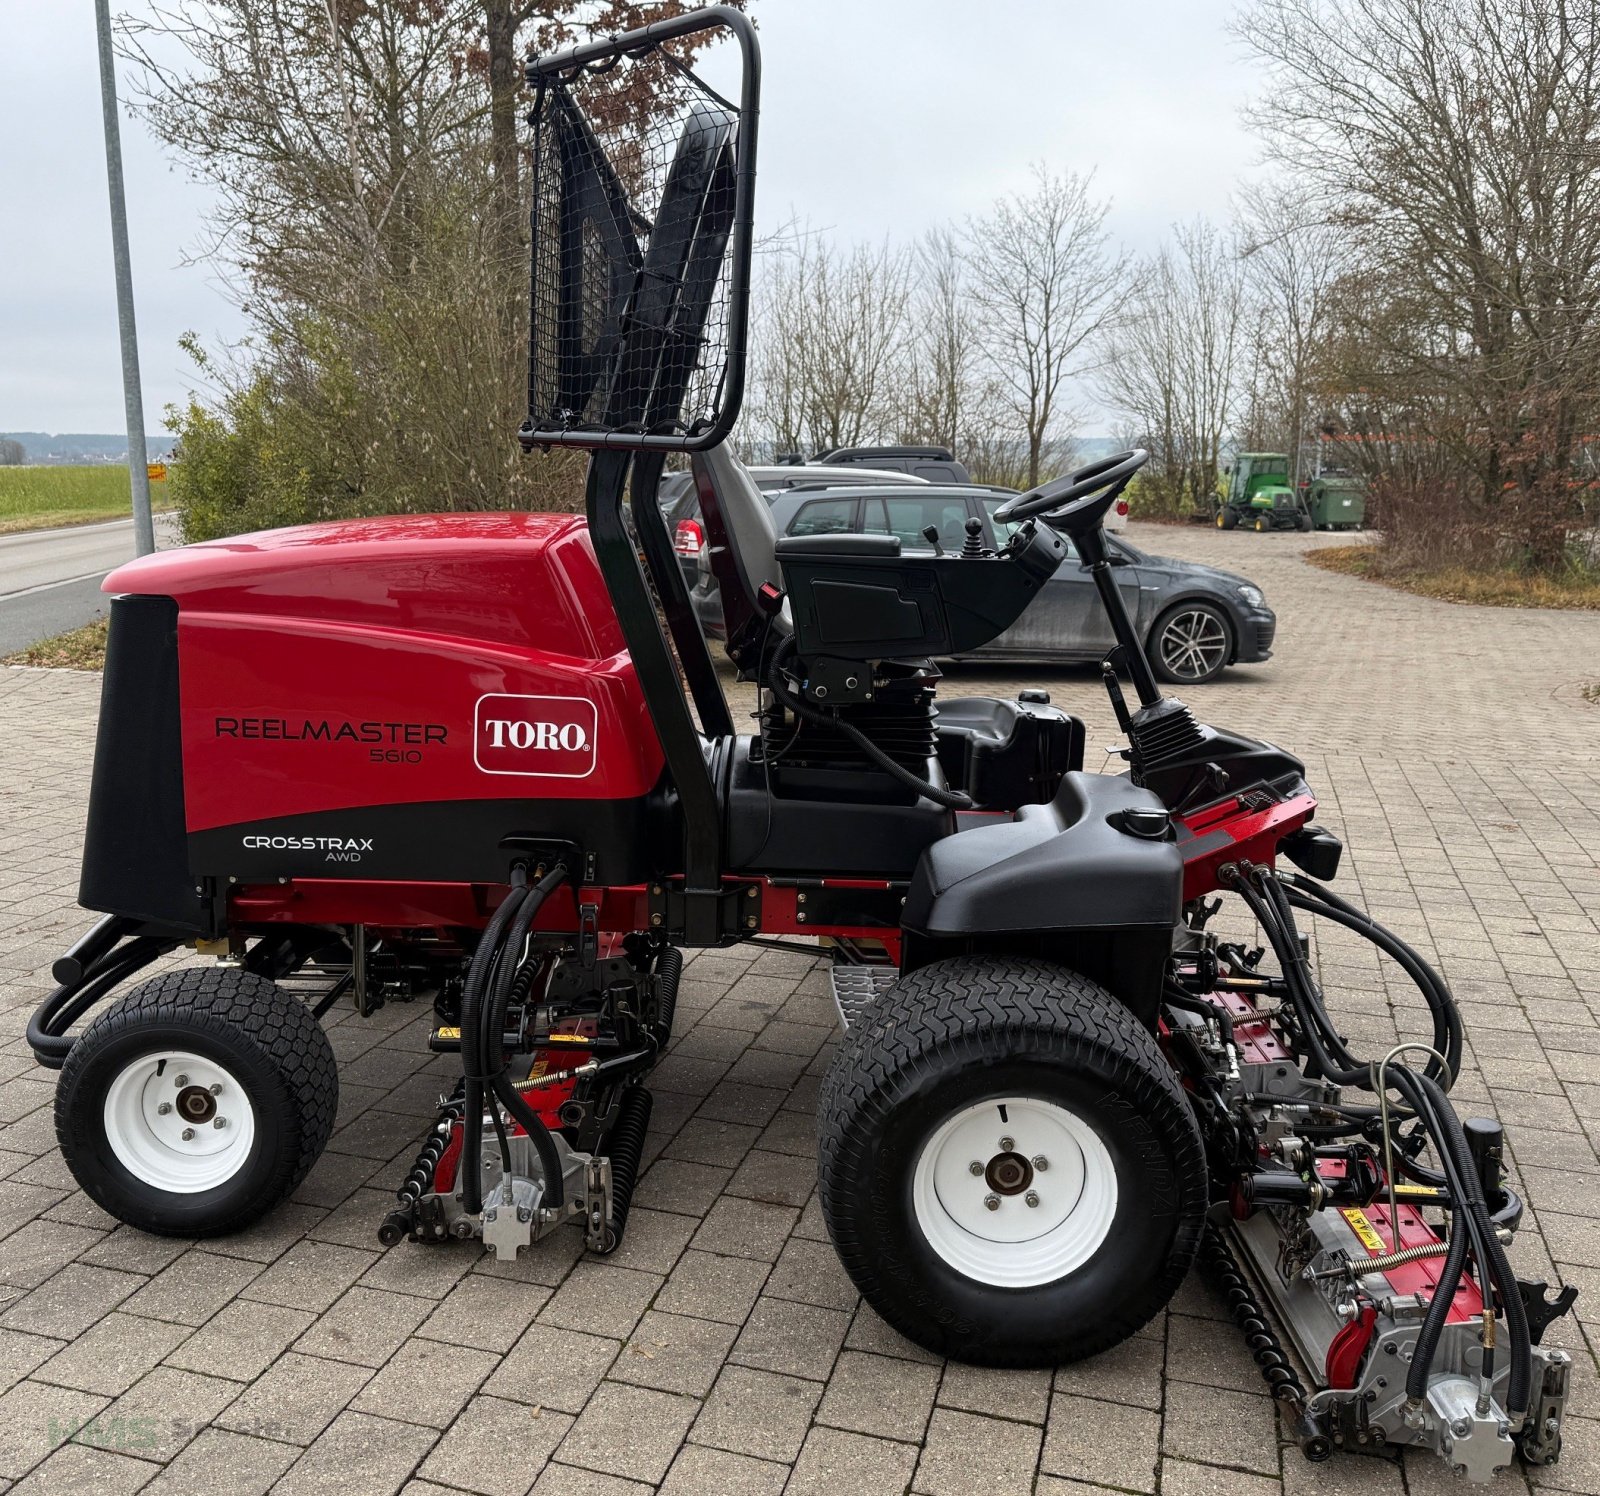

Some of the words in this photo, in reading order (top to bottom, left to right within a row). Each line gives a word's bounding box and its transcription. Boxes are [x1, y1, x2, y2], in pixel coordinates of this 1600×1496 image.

[215, 717, 448, 745] REELMASTER
[369, 749, 422, 764] 5610
[242, 836, 374, 851] CROSSTRAX
[325, 852, 361, 862] AWD
